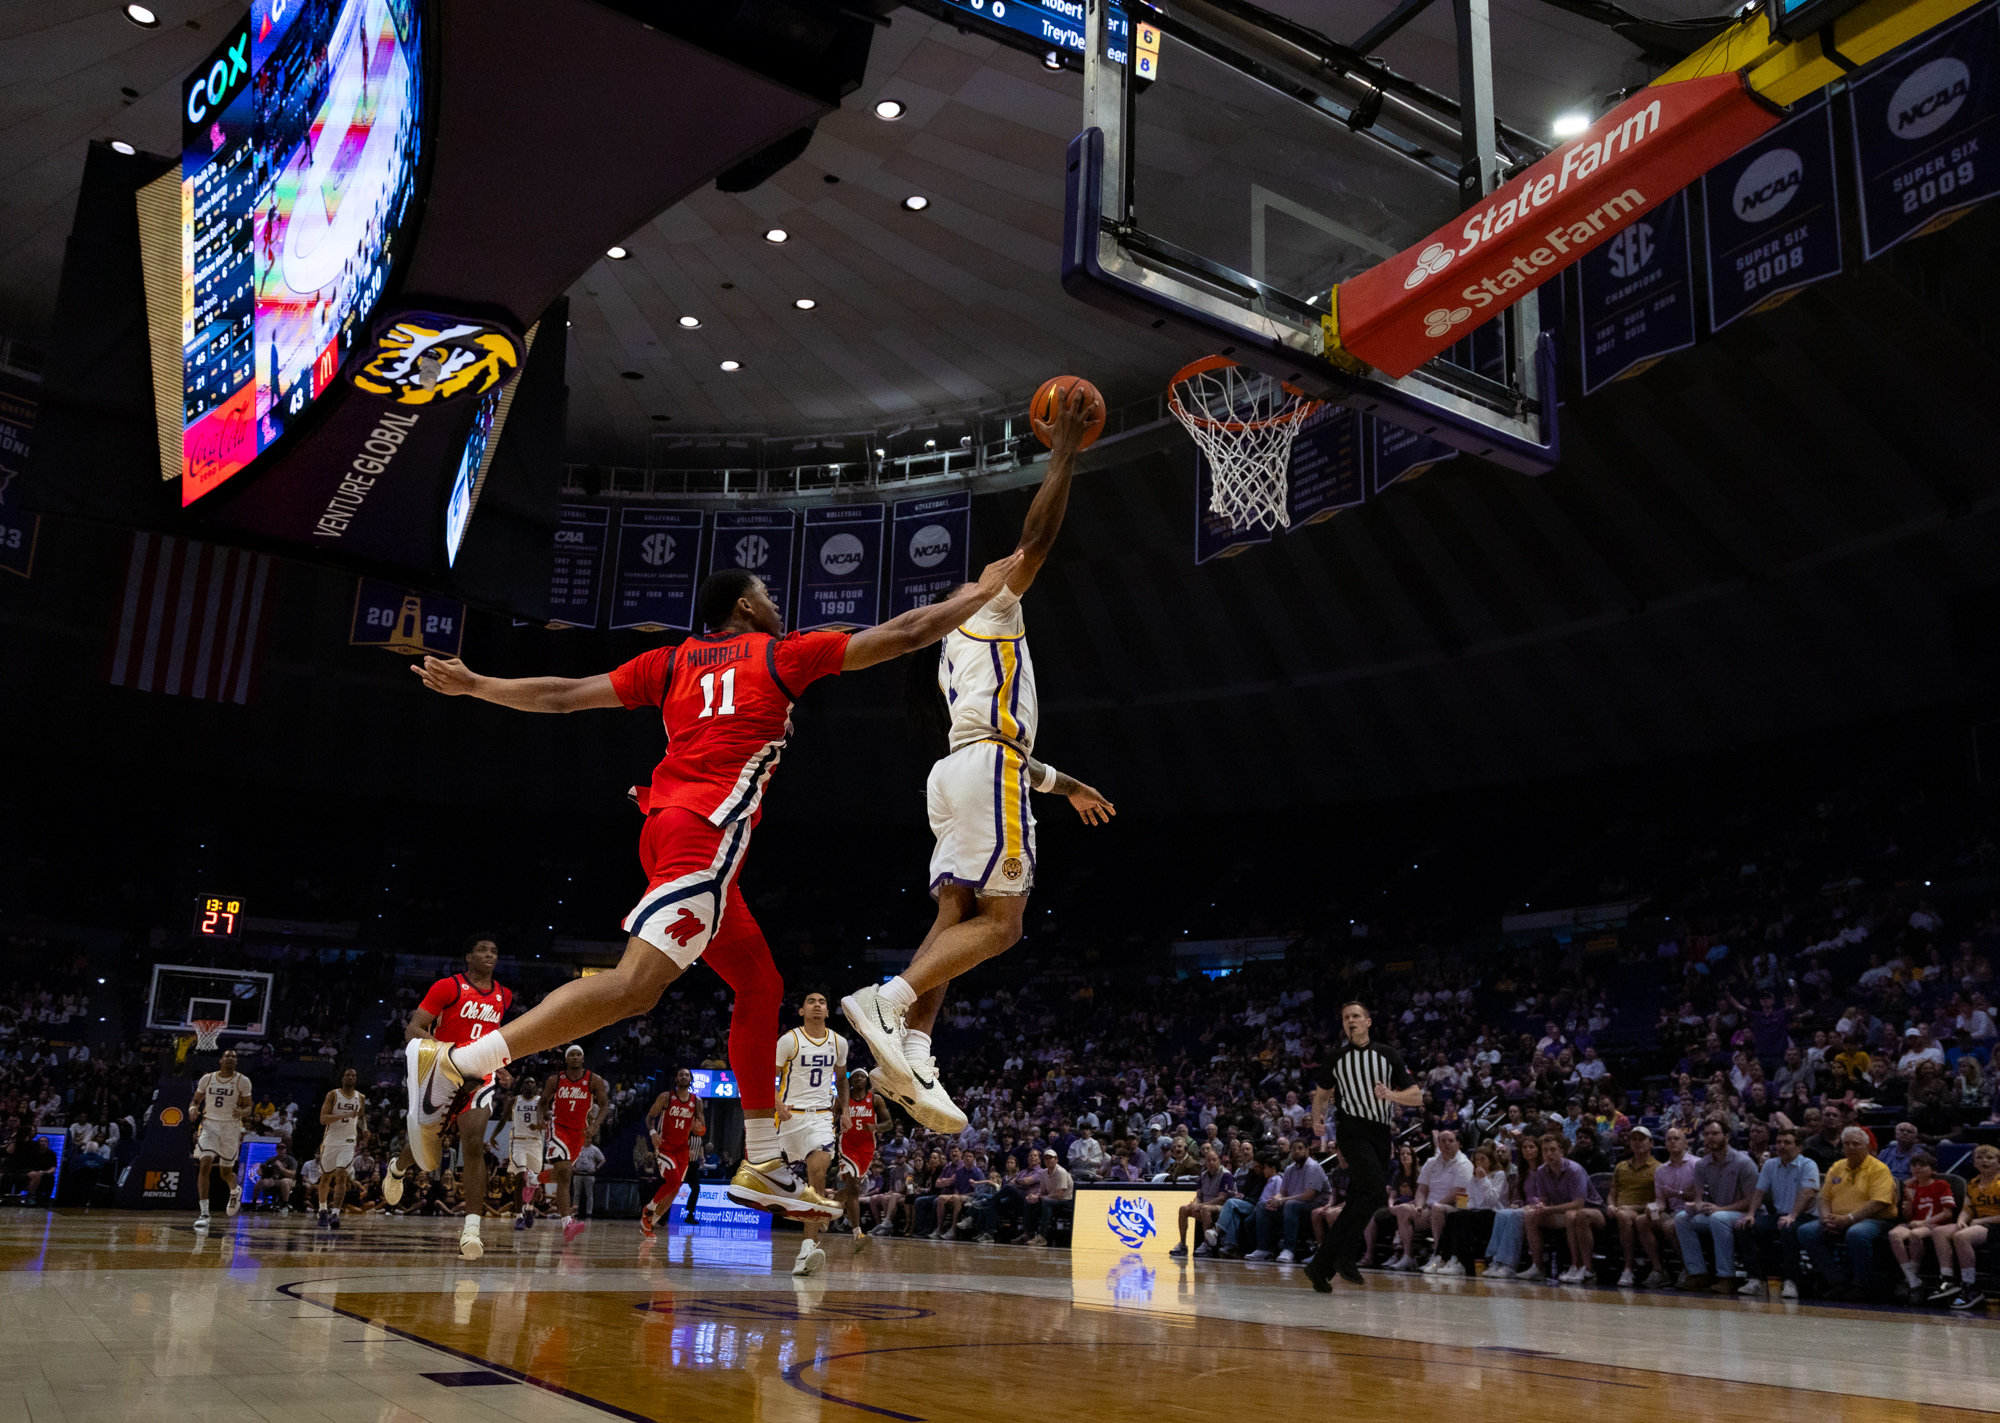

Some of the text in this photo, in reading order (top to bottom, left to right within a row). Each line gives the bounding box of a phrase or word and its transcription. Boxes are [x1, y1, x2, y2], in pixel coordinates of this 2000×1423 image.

[1142, 30, 1153, 44] 6
[1041, 19, 1086, 52] Trey'De
[1140, 58, 1150, 72] 8
[187, 32, 248, 124] COX
[1898, 79, 1969, 131] NCAA
[1893, 137, 1979, 193] SUPER SIX
[1742, 169, 1802, 214] NCAA
[1902, 160, 1975, 214] 2009
[1607, 222, 1655, 278] SEC
[1735, 224, 1809, 272] SUPER SIX
[1743, 246, 1804, 292] 2008
[360, 266, 382, 323] 13:10
[1604, 268, 1663, 306] CHAMPIONS
[290, 388, 304, 416] 43
[312, 412, 420, 537] VENTURE GLOBAL
[826, 510, 862, 518] VOLLEYBALL
[554, 530, 584, 543] CAA
[641, 533, 677, 566] SEC
[734, 535, 770, 569] SEC
[913, 543, 949, 558] NCAA
[824, 552, 861, 565] NCAA
[814, 590, 863, 600] FINAL FOUR
[905, 584, 927, 595] FINAL
[821, 600, 855, 615] 1990
[366, 607, 453, 635] 20 24
[687, 642, 752, 668] MURRELL
[698, 668, 736, 719] 11
[206, 898, 240, 914] 13:10
[201, 911, 235, 934] 27
[460, 1000, 501, 1023] Ole Miss
[470, 1023, 483, 1040] 0
[801, 1055, 834, 1067] LSU
[810, 1068, 822, 1087] 0
[209, 1088, 234, 1096] LSU
[558, 1086, 588, 1099] Ole Miss
[715, 1083, 733, 1096] 43
[214, 1097, 224, 1108] 6
[337, 1103, 359, 1111] LSU
[569, 1100, 576, 1112] 7
[524, 1113, 531, 1123] 8
[669, 1105, 694, 1118] Ole Miss
[855, 1105, 873, 1117] Miss
[674, 1119, 685, 1129] 14
[856, 1119, 863, 1130] 5
[695, 1211, 701, 1220] to
[700, 1211, 722, 1223] support
[722, 1212, 733, 1223] LSU
[733, 1212, 760, 1224] Athletics
